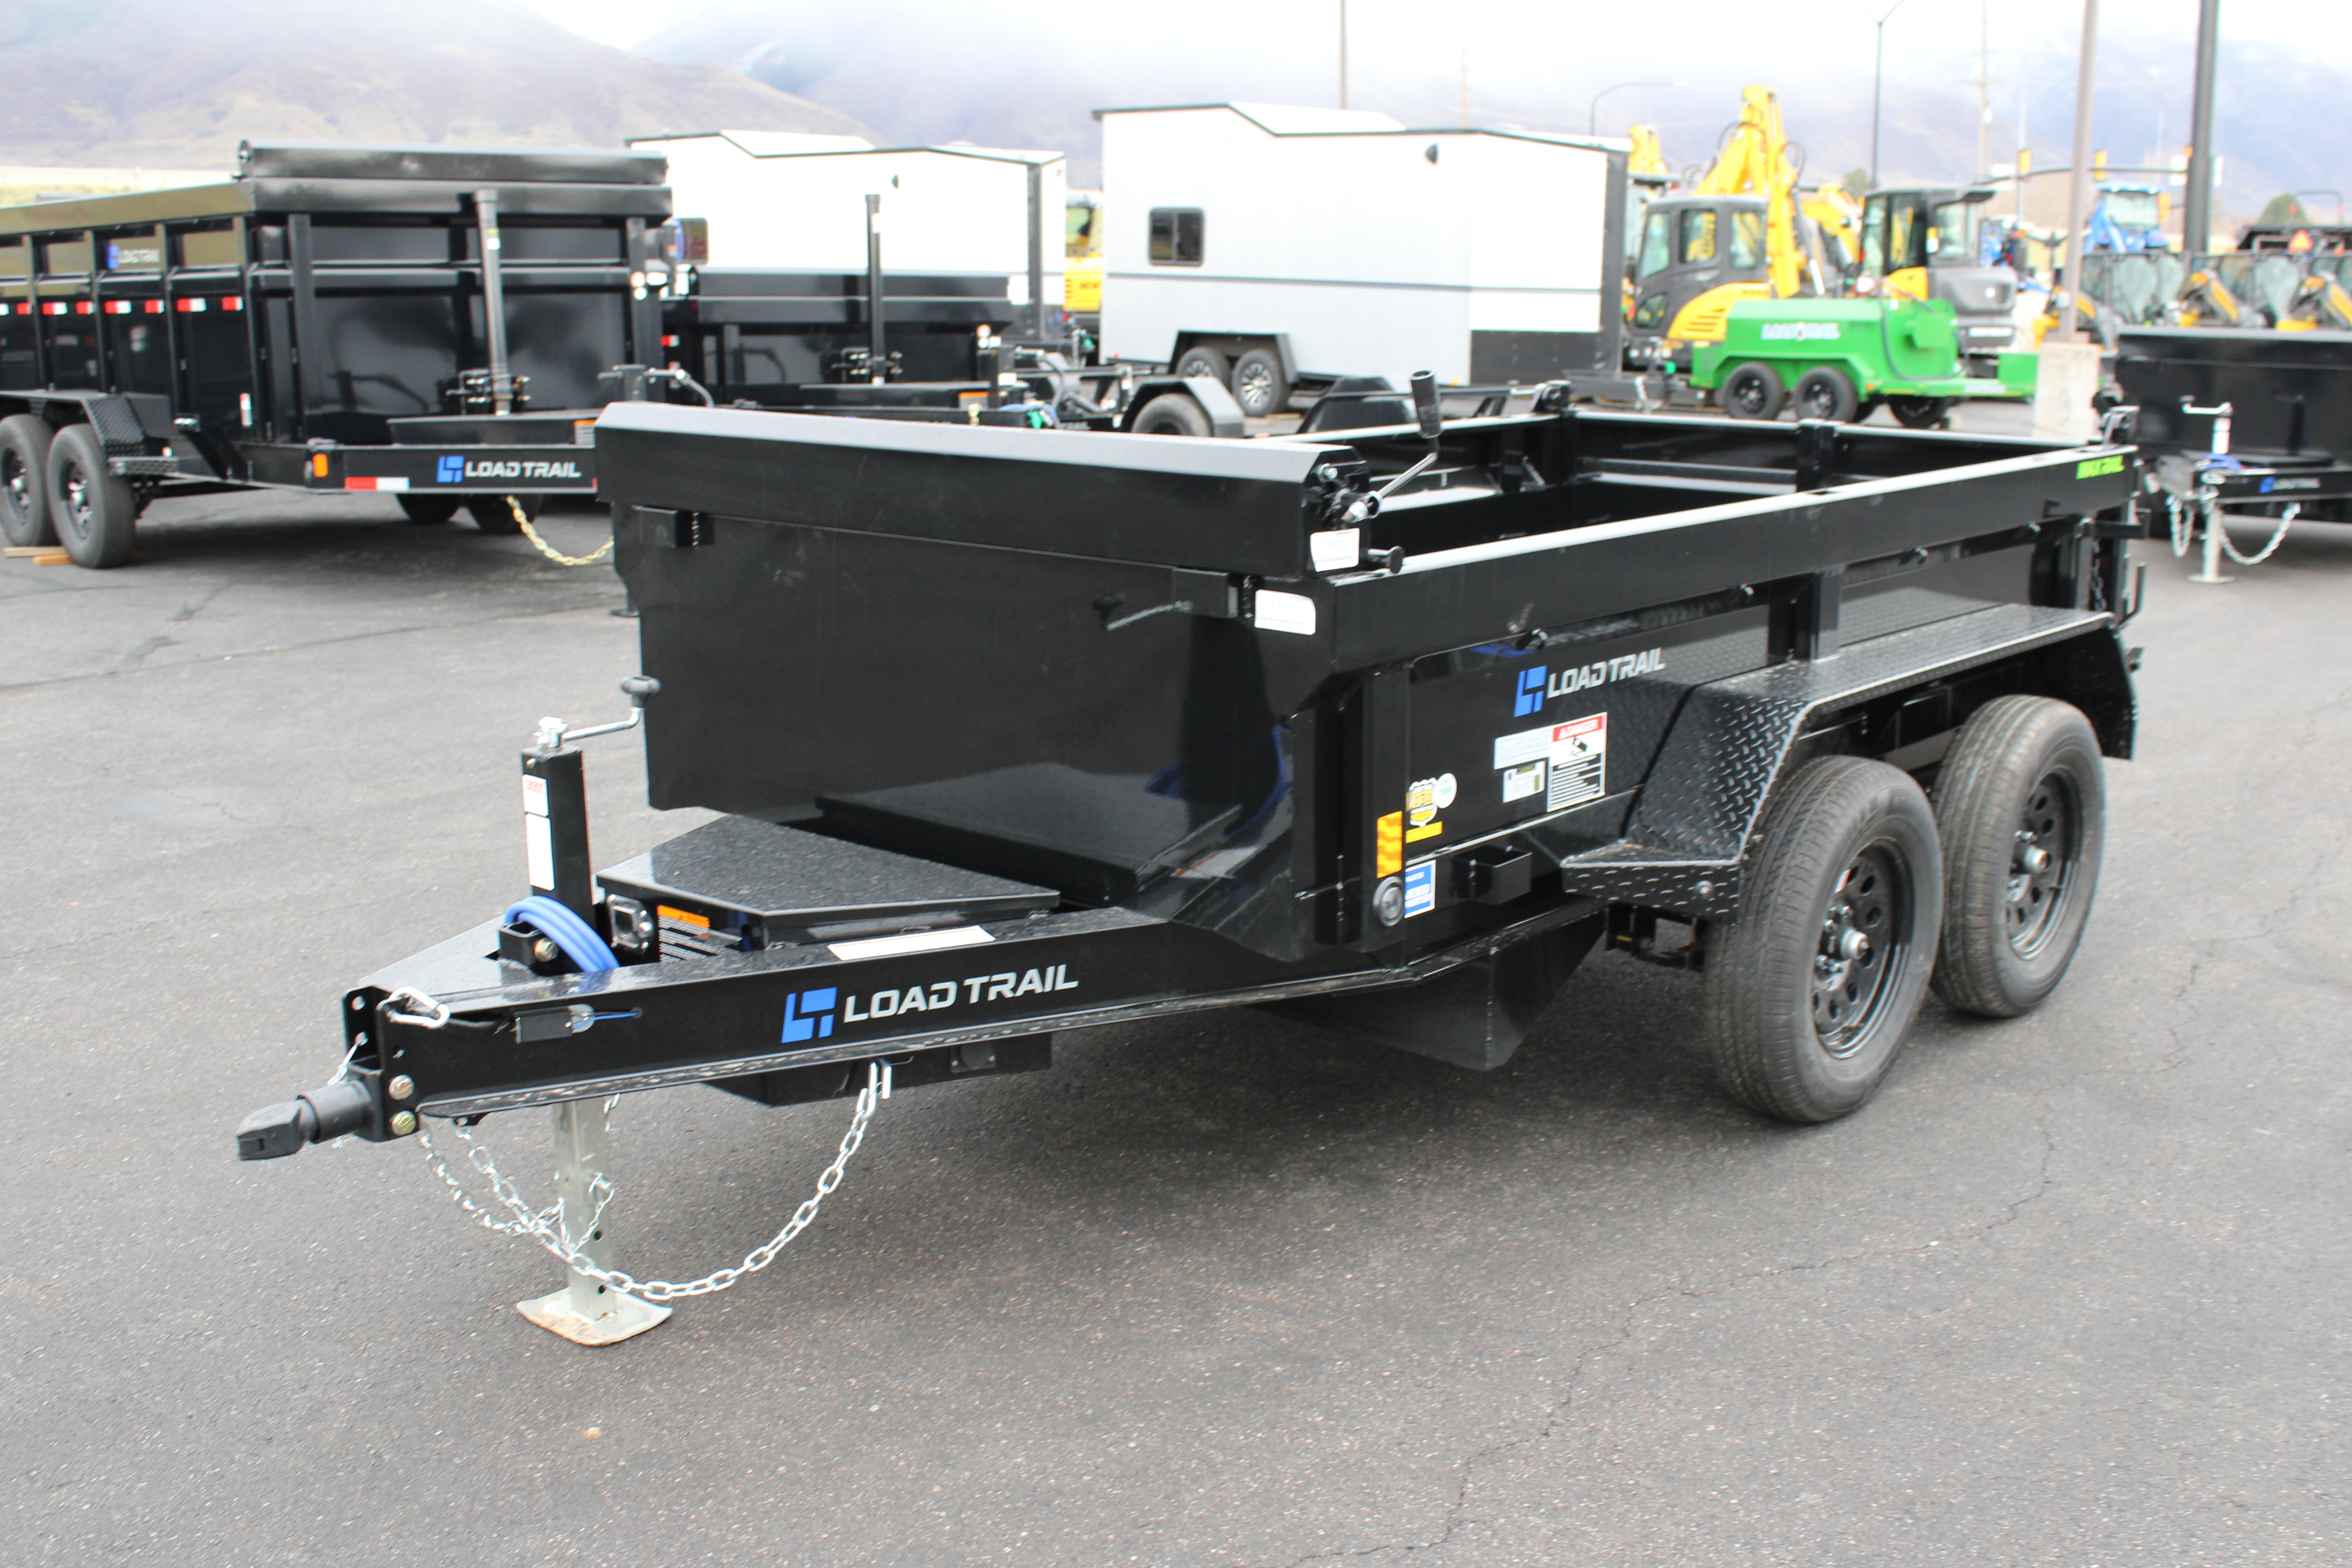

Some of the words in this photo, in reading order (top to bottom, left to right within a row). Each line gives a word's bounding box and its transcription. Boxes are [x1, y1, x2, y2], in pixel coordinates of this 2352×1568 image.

[465, 461, 521, 478] LOAD
[522, 461, 582, 478] TRAIL
[1546, 661, 1607, 699] LOAD
[1607, 648, 1666, 682] TRAIL
[844, 981, 958, 1023] LOAD
[963, 964, 1079, 1004] TRAIL
